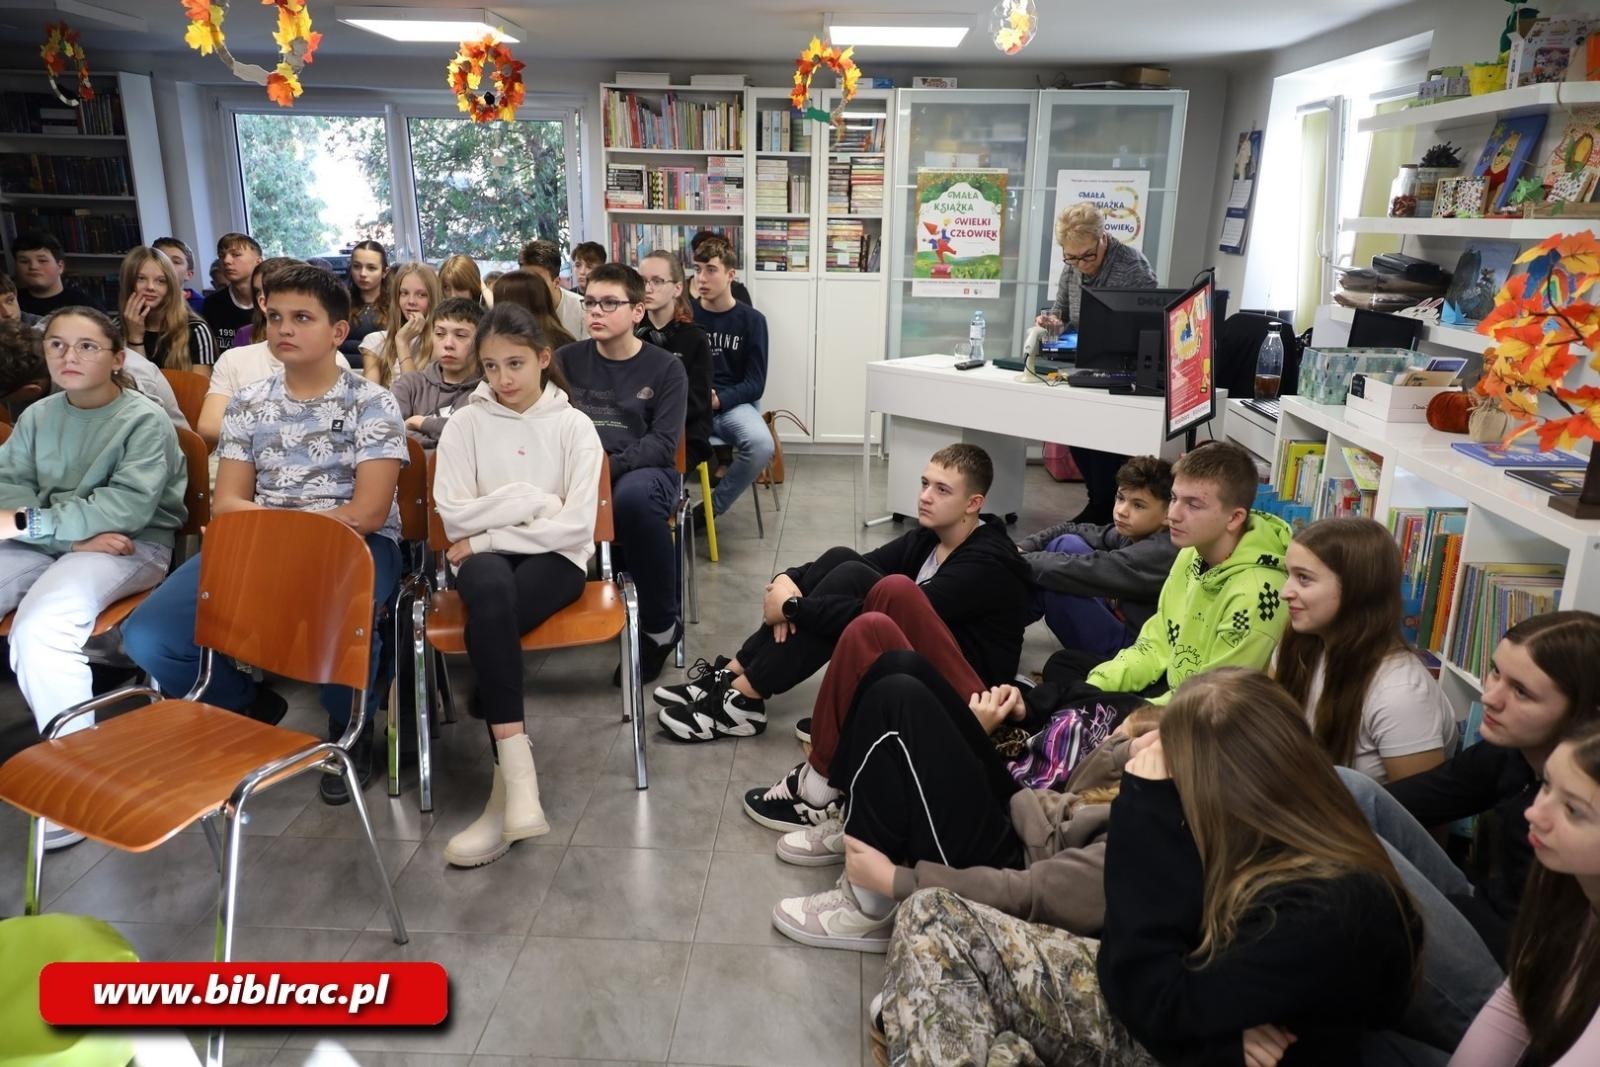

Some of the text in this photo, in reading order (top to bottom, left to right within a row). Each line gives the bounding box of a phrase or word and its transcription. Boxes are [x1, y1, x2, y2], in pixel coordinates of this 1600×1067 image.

[947, 190, 979, 200] MAŁA
[1078, 191, 1106, 199] MAŁA
[934, 201, 974, 214] KSIĄŻKA
[1093, 200, 1125, 210] SIĄŻKA
[954, 216, 991, 227] WIELKI
[1104, 223, 1135, 233] OWIEK
[950, 228, 998, 241] CZŁOWIEK
